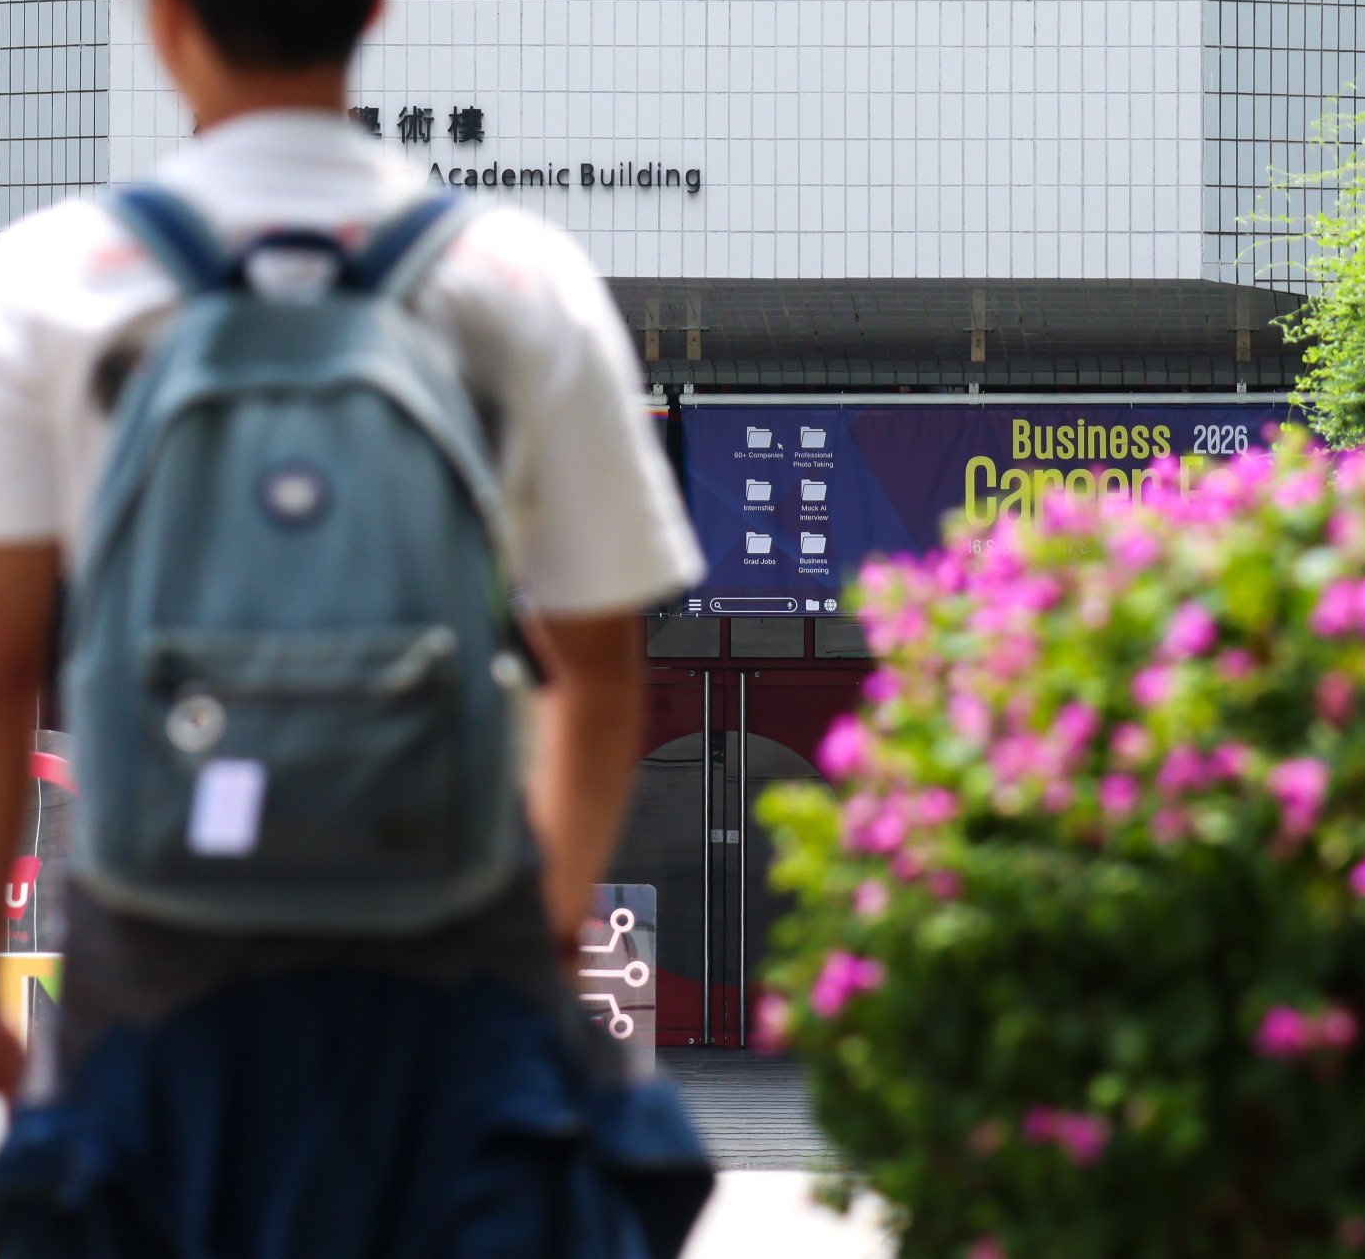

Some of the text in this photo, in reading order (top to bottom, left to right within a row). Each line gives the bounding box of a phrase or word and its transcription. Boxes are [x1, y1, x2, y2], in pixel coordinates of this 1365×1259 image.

[427, 161, 701, 194] Academic Building
[1012, 419, 1248, 460] Business 2026
[734, 451, 784, 461] 60+ Companies
[794, 451, 833, 459] Professional
[793, 460, 834, 469] Photo Taking
[743, 504, 775, 512] Internship
[801, 504, 820, 512] Mock
[799, 513, 829, 521] Interview
[799, 557, 828, 565] Business
[798, 566, 829, 575] Grooming
